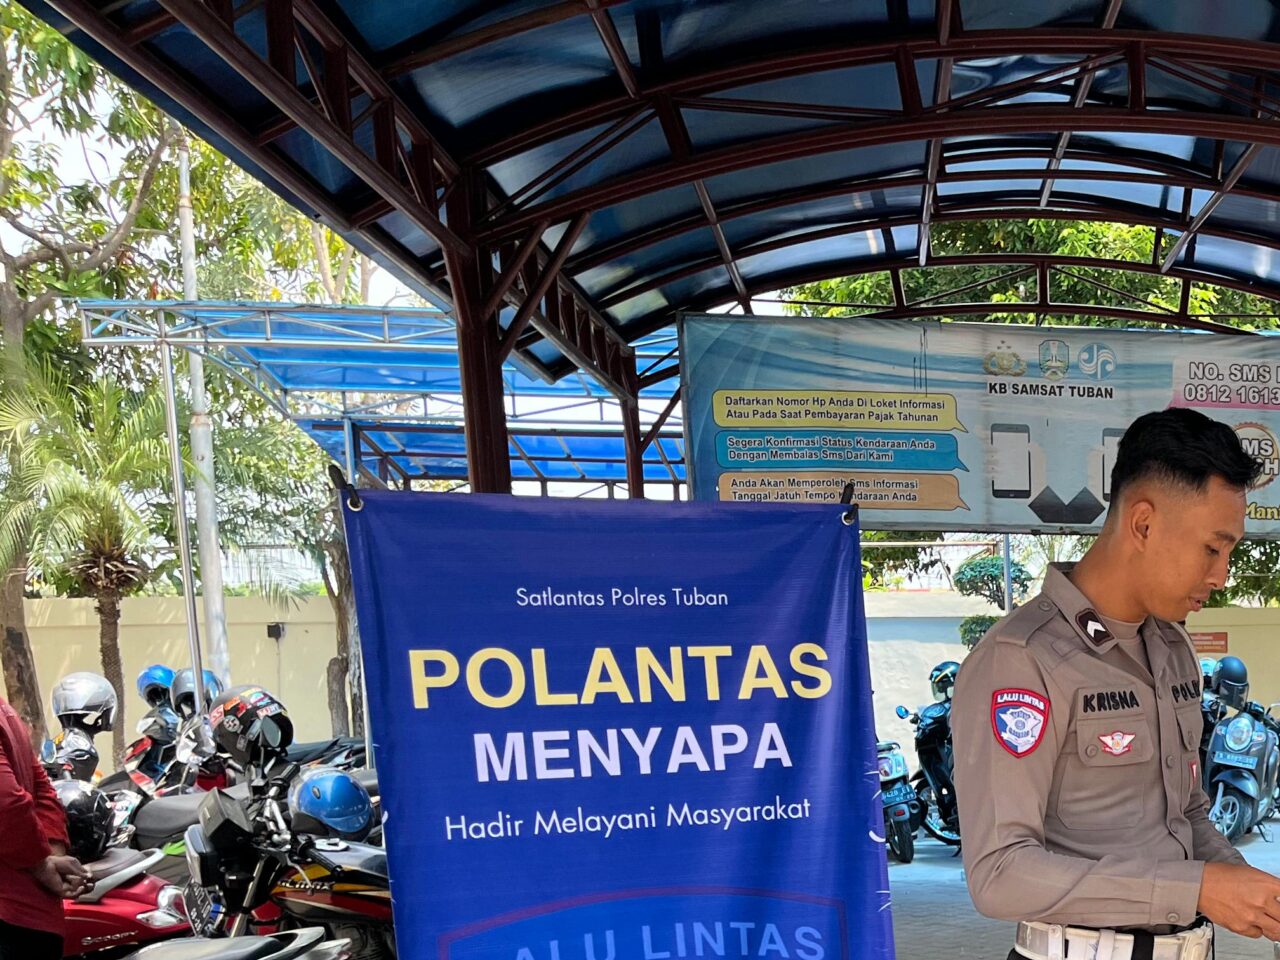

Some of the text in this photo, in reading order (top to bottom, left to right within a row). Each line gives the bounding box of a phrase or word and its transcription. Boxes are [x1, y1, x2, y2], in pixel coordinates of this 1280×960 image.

[1189, 362, 1224, 380] NO.
[1229, 364, 1271, 383] SMS
[988, 383, 1113, 398] KB SAMSAT TUBAN
[1184, 383, 1231, 403] 0812
[725, 396, 945, 409] Daftarkan Nomor Hp Anda Di Loket Informasi
[726, 409, 938, 423] Atau Pada Saat Pembayaran Pajak Tahunan
[728, 436, 935, 449] Segera Konfirmasi Status Kendaraan Anda
[1240, 438, 1274, 456] MS
[728, 449, 893, 462] Dengan Membalas Sms Dari Kami
[731, 479, 918, 490] Anda Akan Memperoleh Sms Informasi
[732, 491, 771, 502] Tanggal
[774, 491, 800, 500] Jatuh
[804, 491, 835, 501] Tempo
[892, 492, 917, 502] Anda
[516, 587, 728, 607] Satlantas Polres Tuban
[408, 642, 833, 709] POLANTAS
[1083, 690, 1140, 713] KRISNA
[473, 722, 793, 783] MENYAPA
[445, 797, 811, 840] Hadir Melayani Masyarakat
